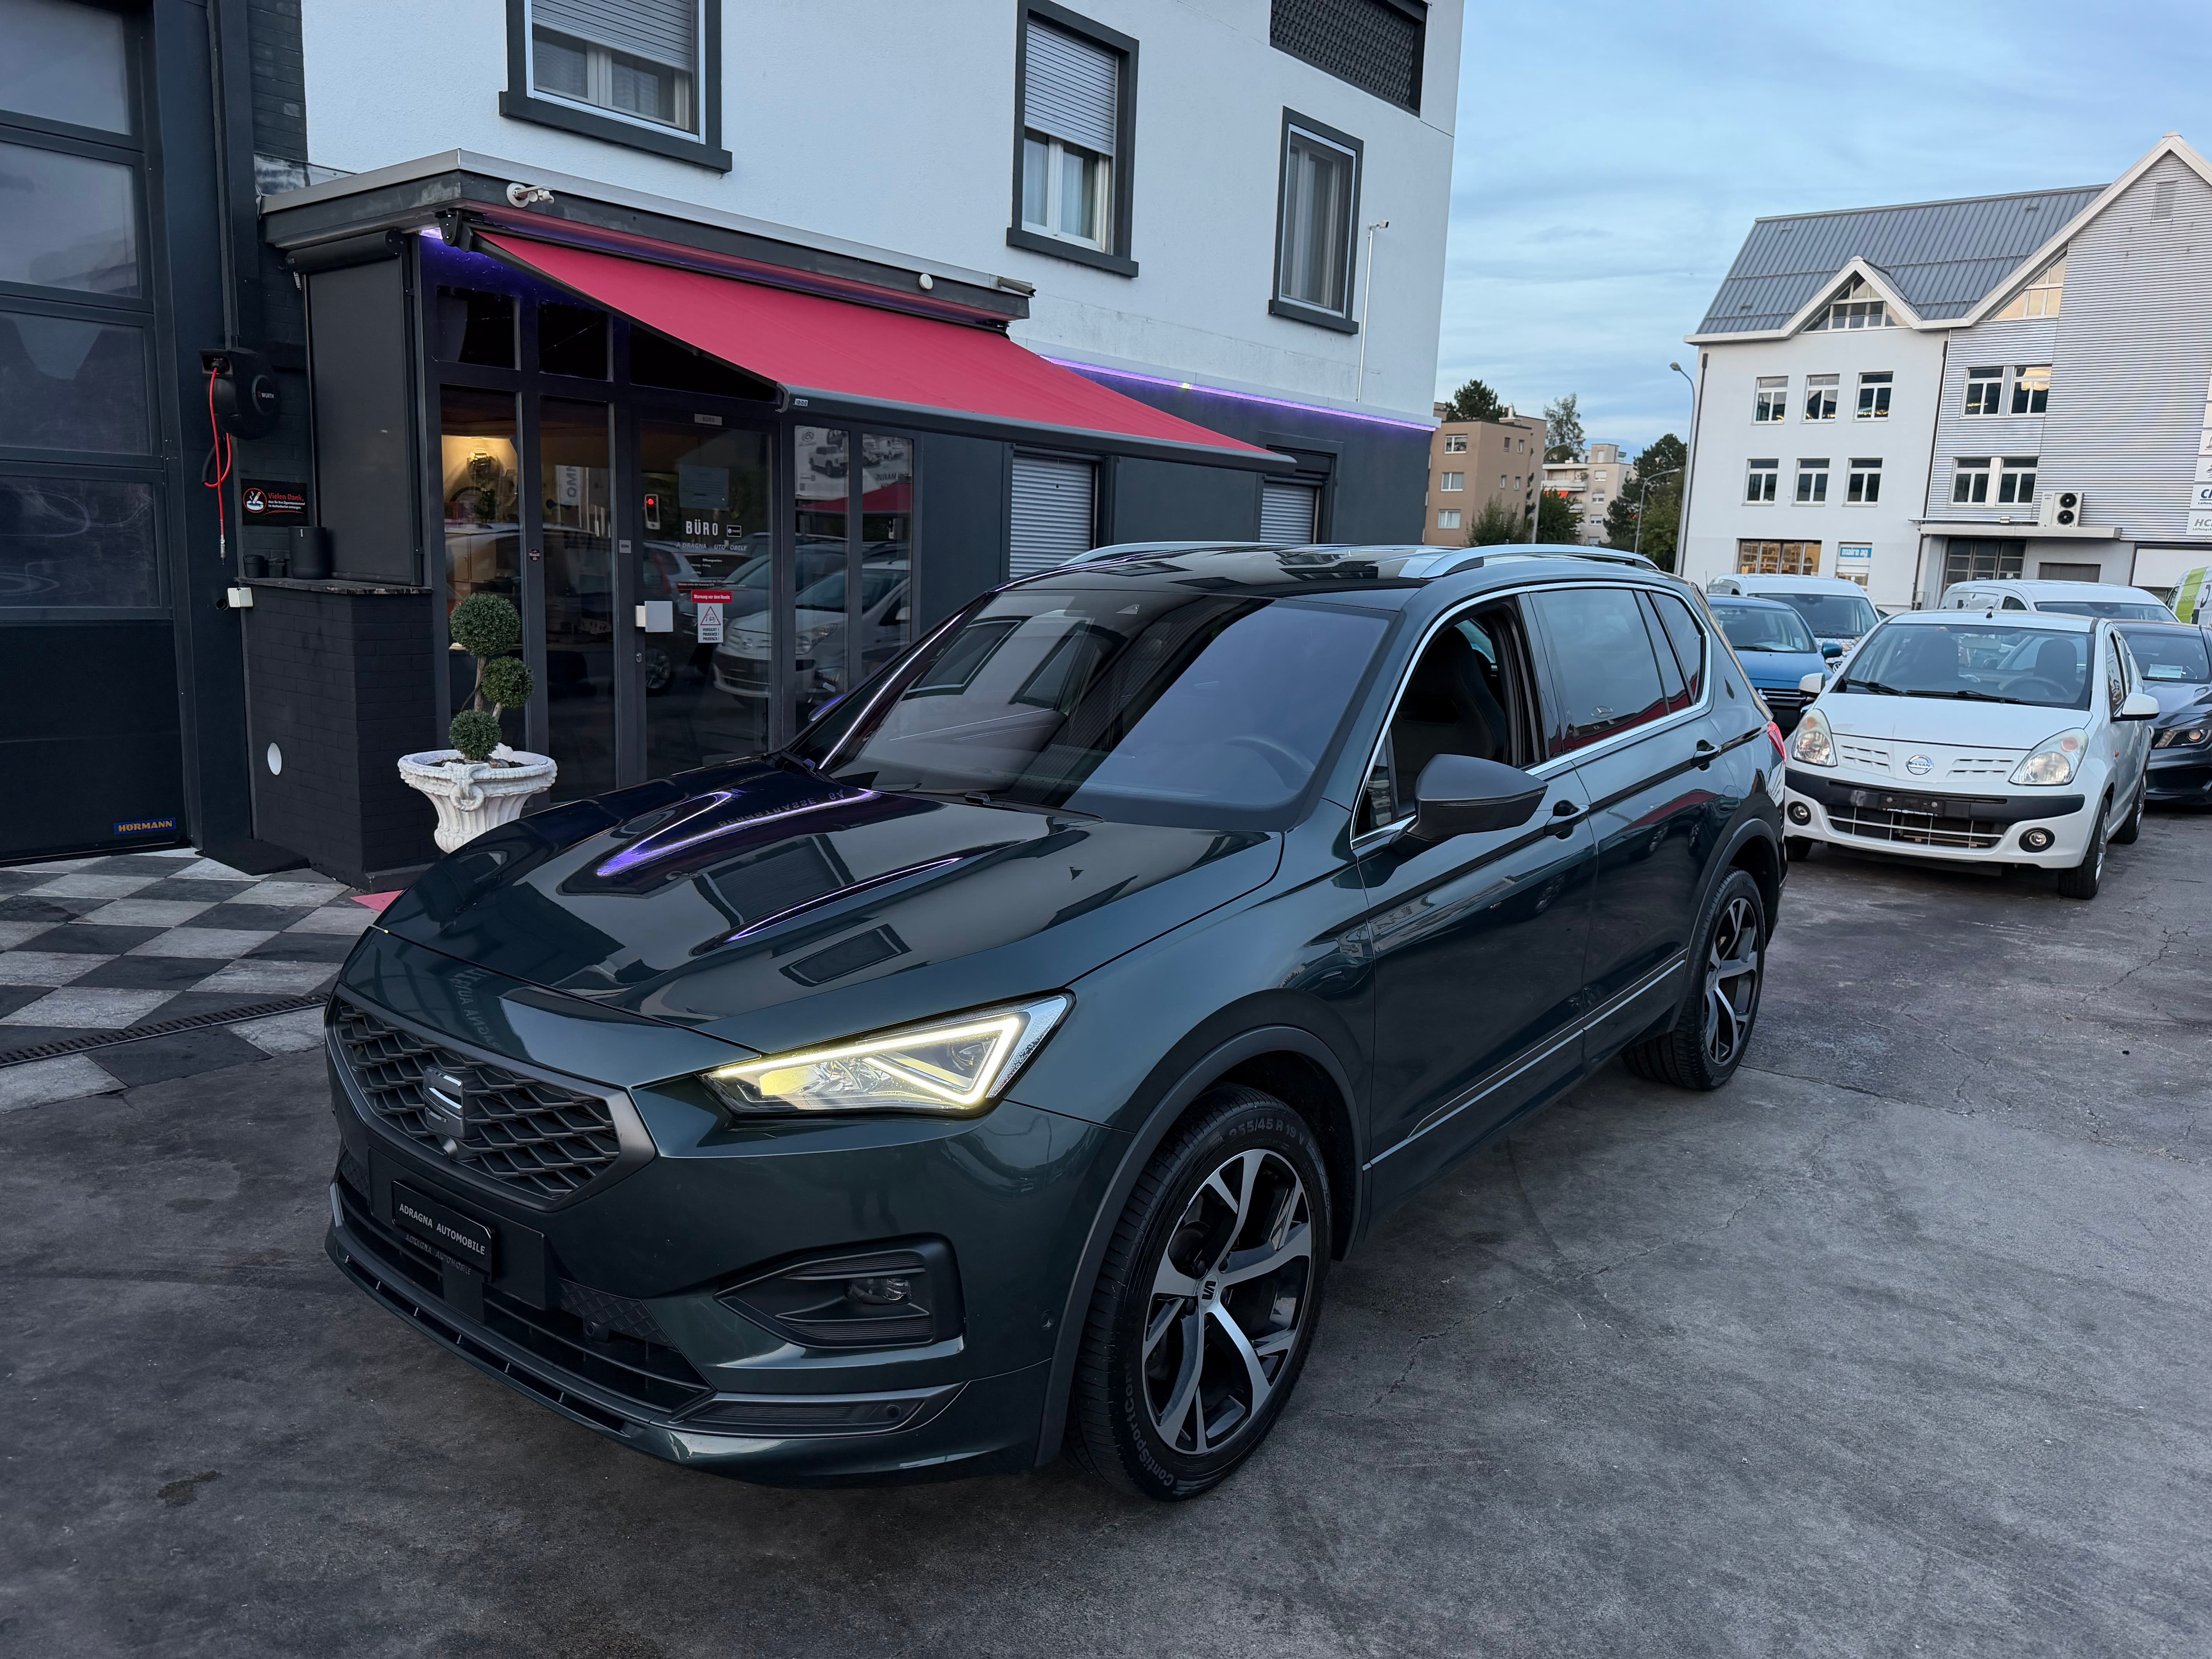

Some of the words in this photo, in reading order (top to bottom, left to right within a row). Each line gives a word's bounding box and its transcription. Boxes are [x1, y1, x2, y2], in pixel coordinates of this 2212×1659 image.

[686, 519, 718, 536] BÜRO
[1860, 549, 1868, 558] ag
[118, 820, 172, 832] HÖRMANN
[1276, 1119, 1283, 1132] R
[1286, 1124, 1297, 1138] 19
[399, 1203, 433, 1228] ADRAGNA
[436, 1223, 486, 1255] AUTOMOBILE
